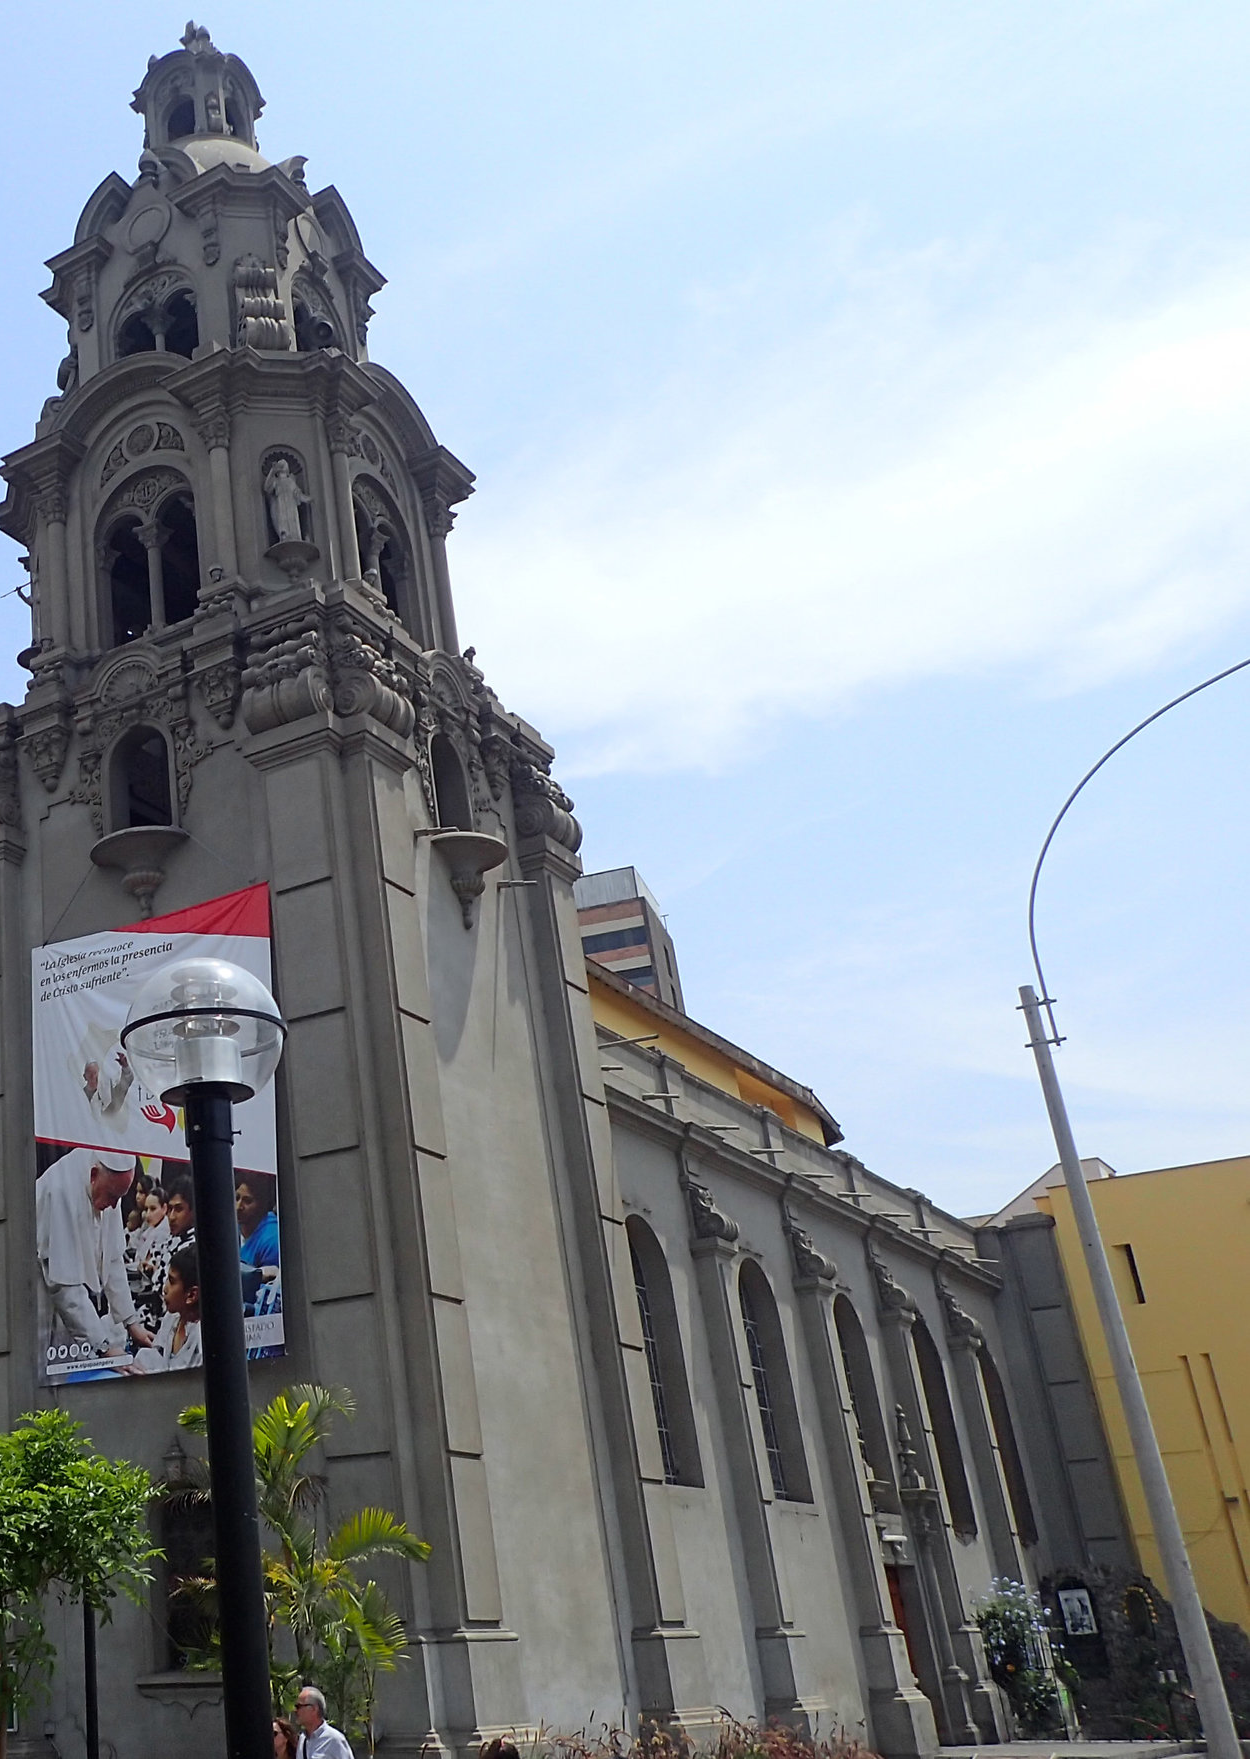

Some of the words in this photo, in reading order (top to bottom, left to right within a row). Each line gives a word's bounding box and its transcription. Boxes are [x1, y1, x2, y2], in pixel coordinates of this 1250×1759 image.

[40, 977, 51, 987] en
[53, 973, 66, 983] los
[67, 959, 109, 980] enfermos
[111, 955, 120, 966] la
[122, 941, 173, 965] presencia
[57, 951, 86, 969] Iglesia
[88, 940, 134, 957] reconoce
[40, 991, 51, 1003] de
[53, 985, 79, 998] Cristo
